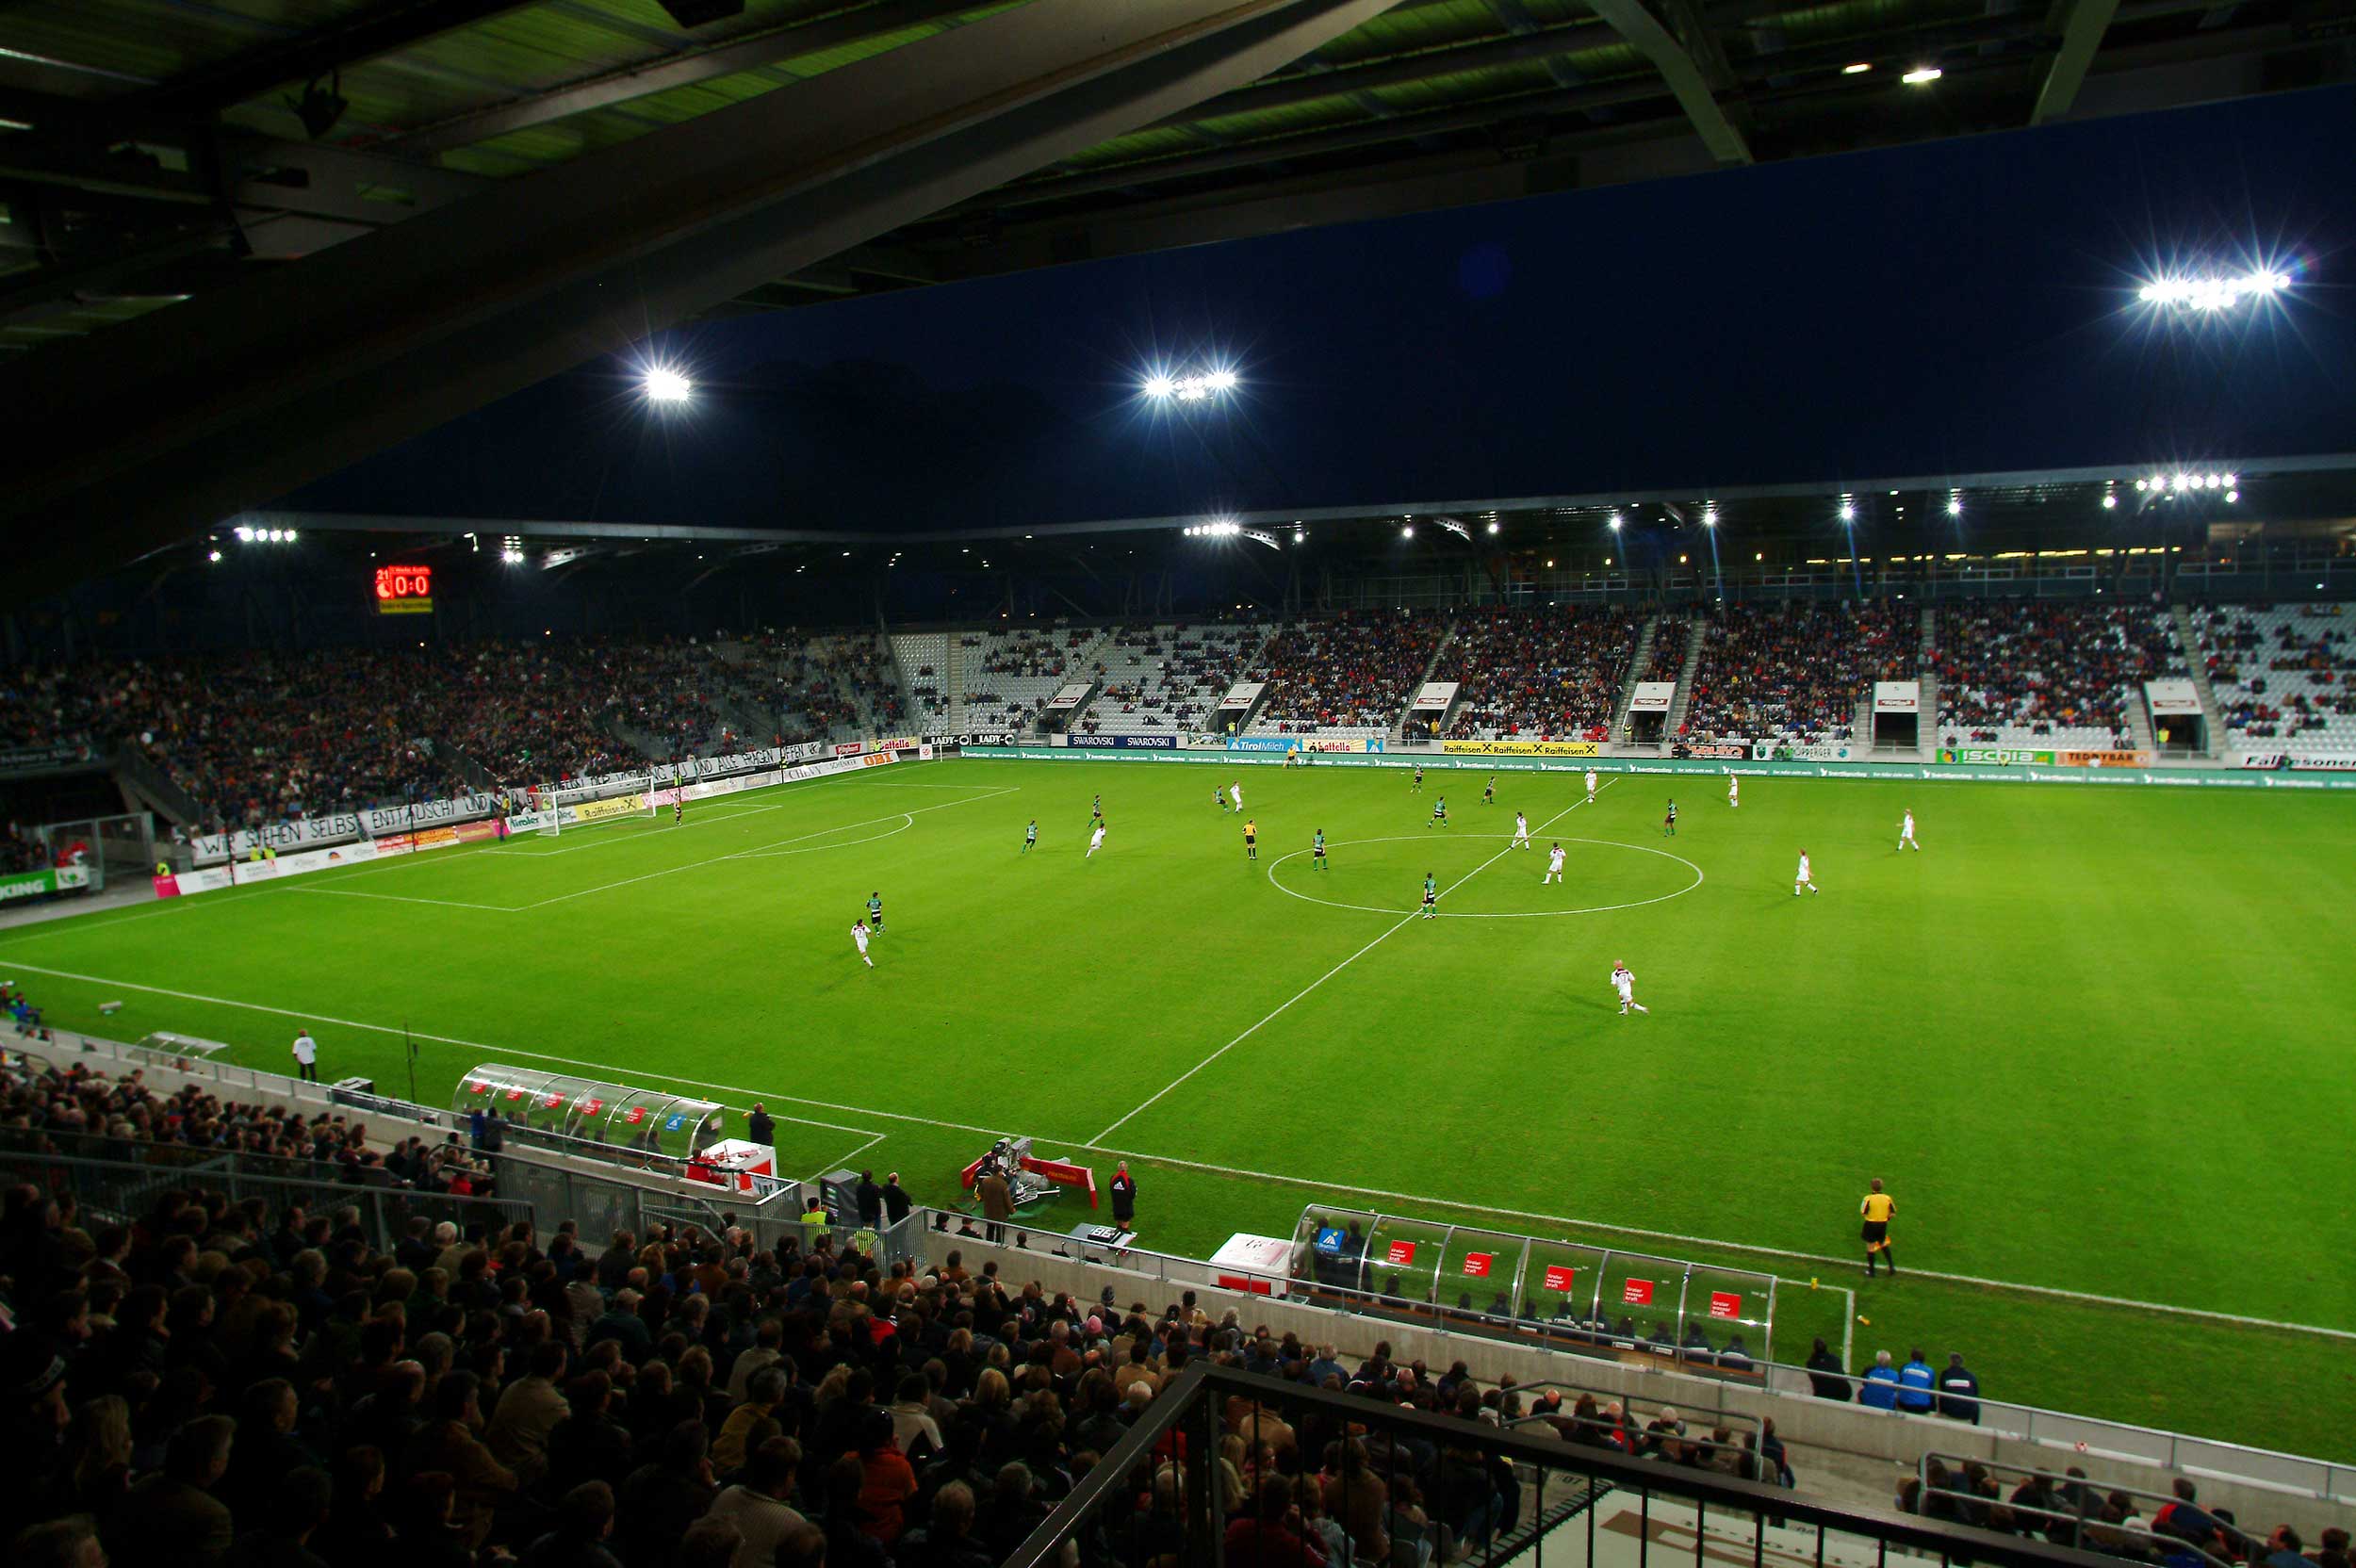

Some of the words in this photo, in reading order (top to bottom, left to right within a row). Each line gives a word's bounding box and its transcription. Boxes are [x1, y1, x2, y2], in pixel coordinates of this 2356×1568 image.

[395, 576, 427, 596] 0:0
[1072, 736, 1114, 745] SWAROVSKI
[1127, 737, 1170, 746] SWAROVSKI
[863, 752, 893, 766] OBI
[584, 804, 627, 820] Raiffeisen
